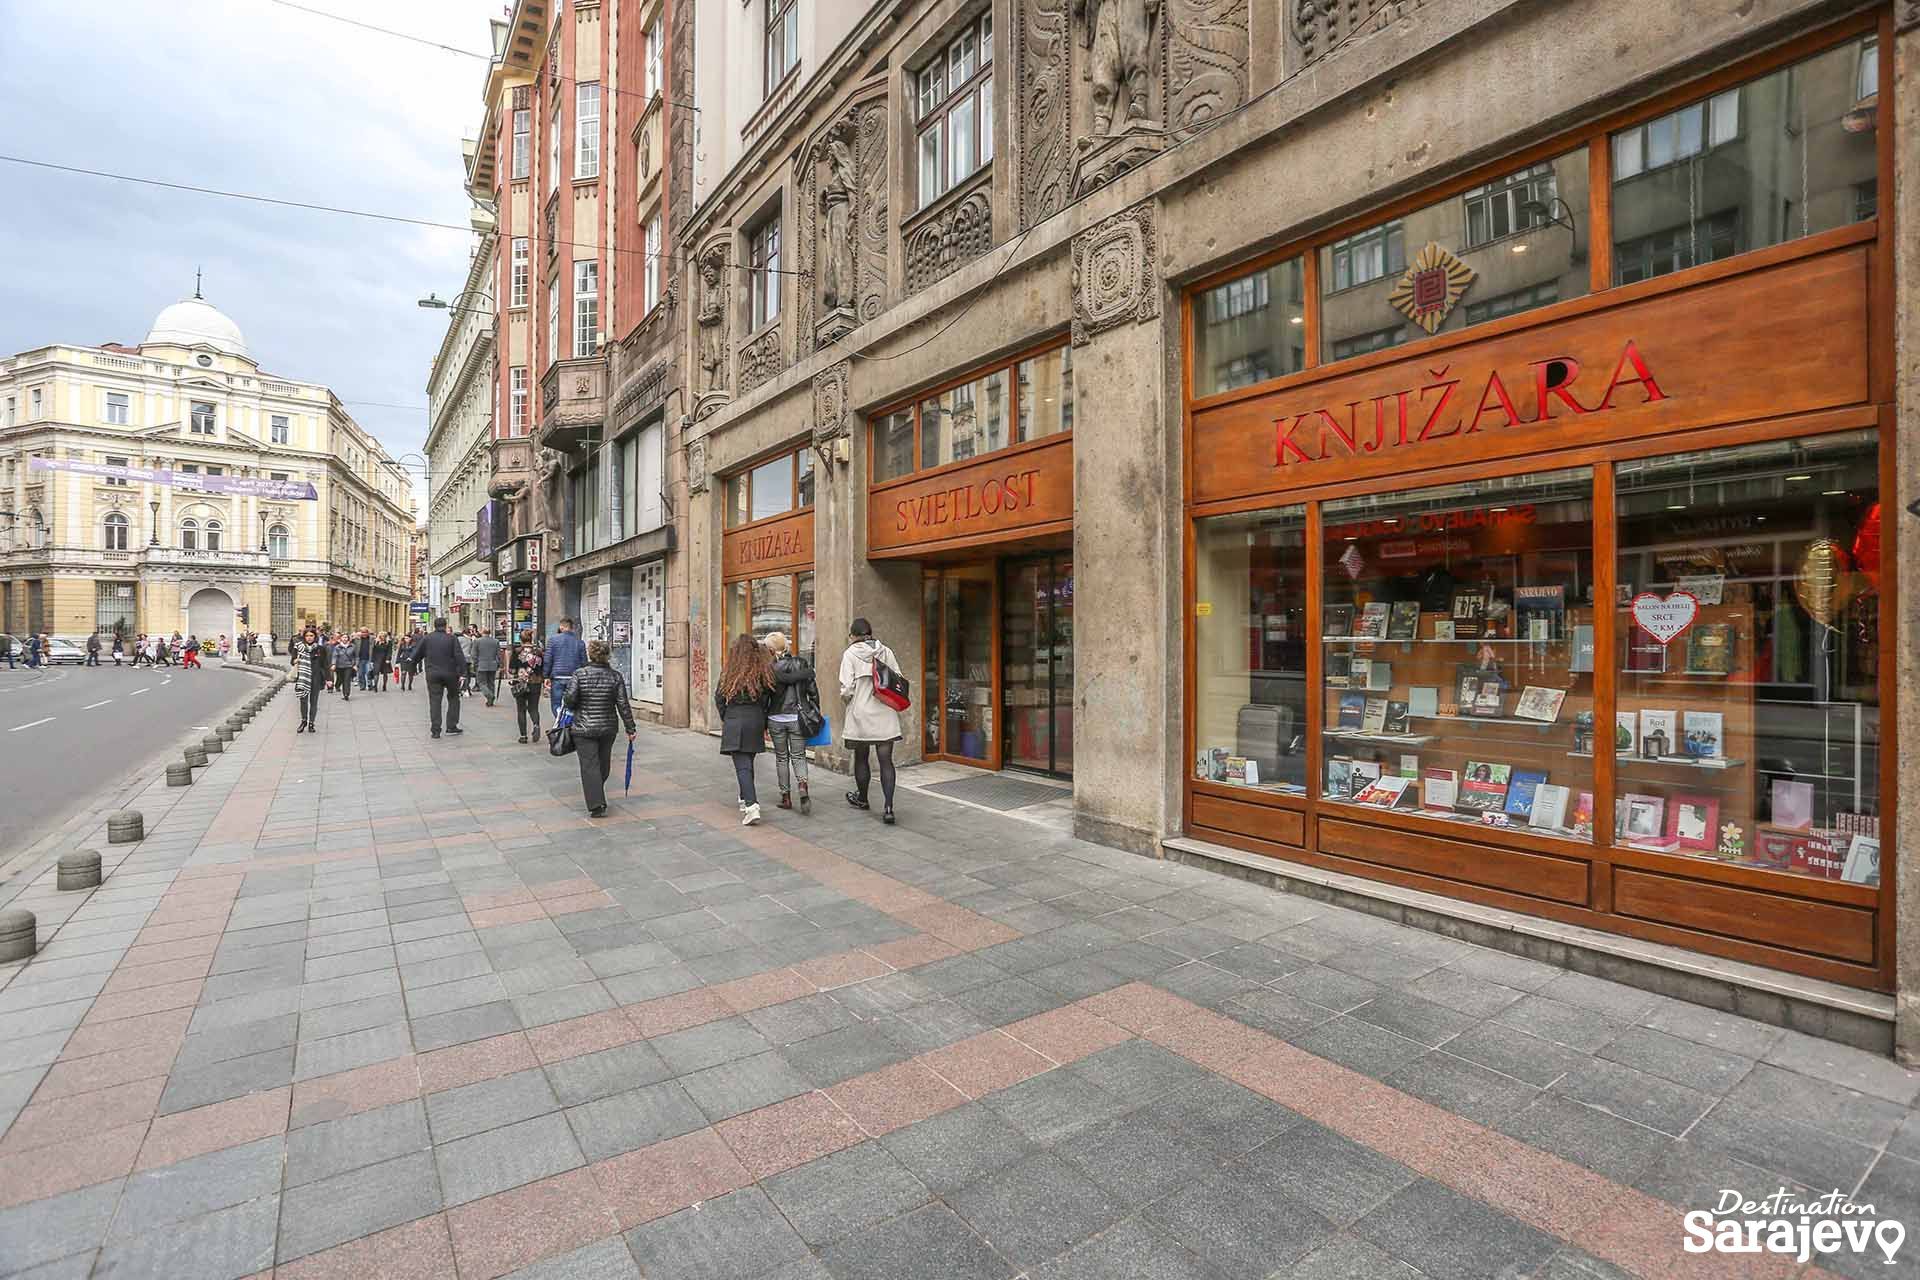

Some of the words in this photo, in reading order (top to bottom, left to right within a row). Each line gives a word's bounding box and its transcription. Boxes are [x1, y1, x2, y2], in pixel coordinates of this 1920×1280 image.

[1272, 339, 1670, 467] KNJIŽARA
[896, 469, 1041, 532] SVJETLOST
[739, 528, 804, 564] KNJIŽARA
